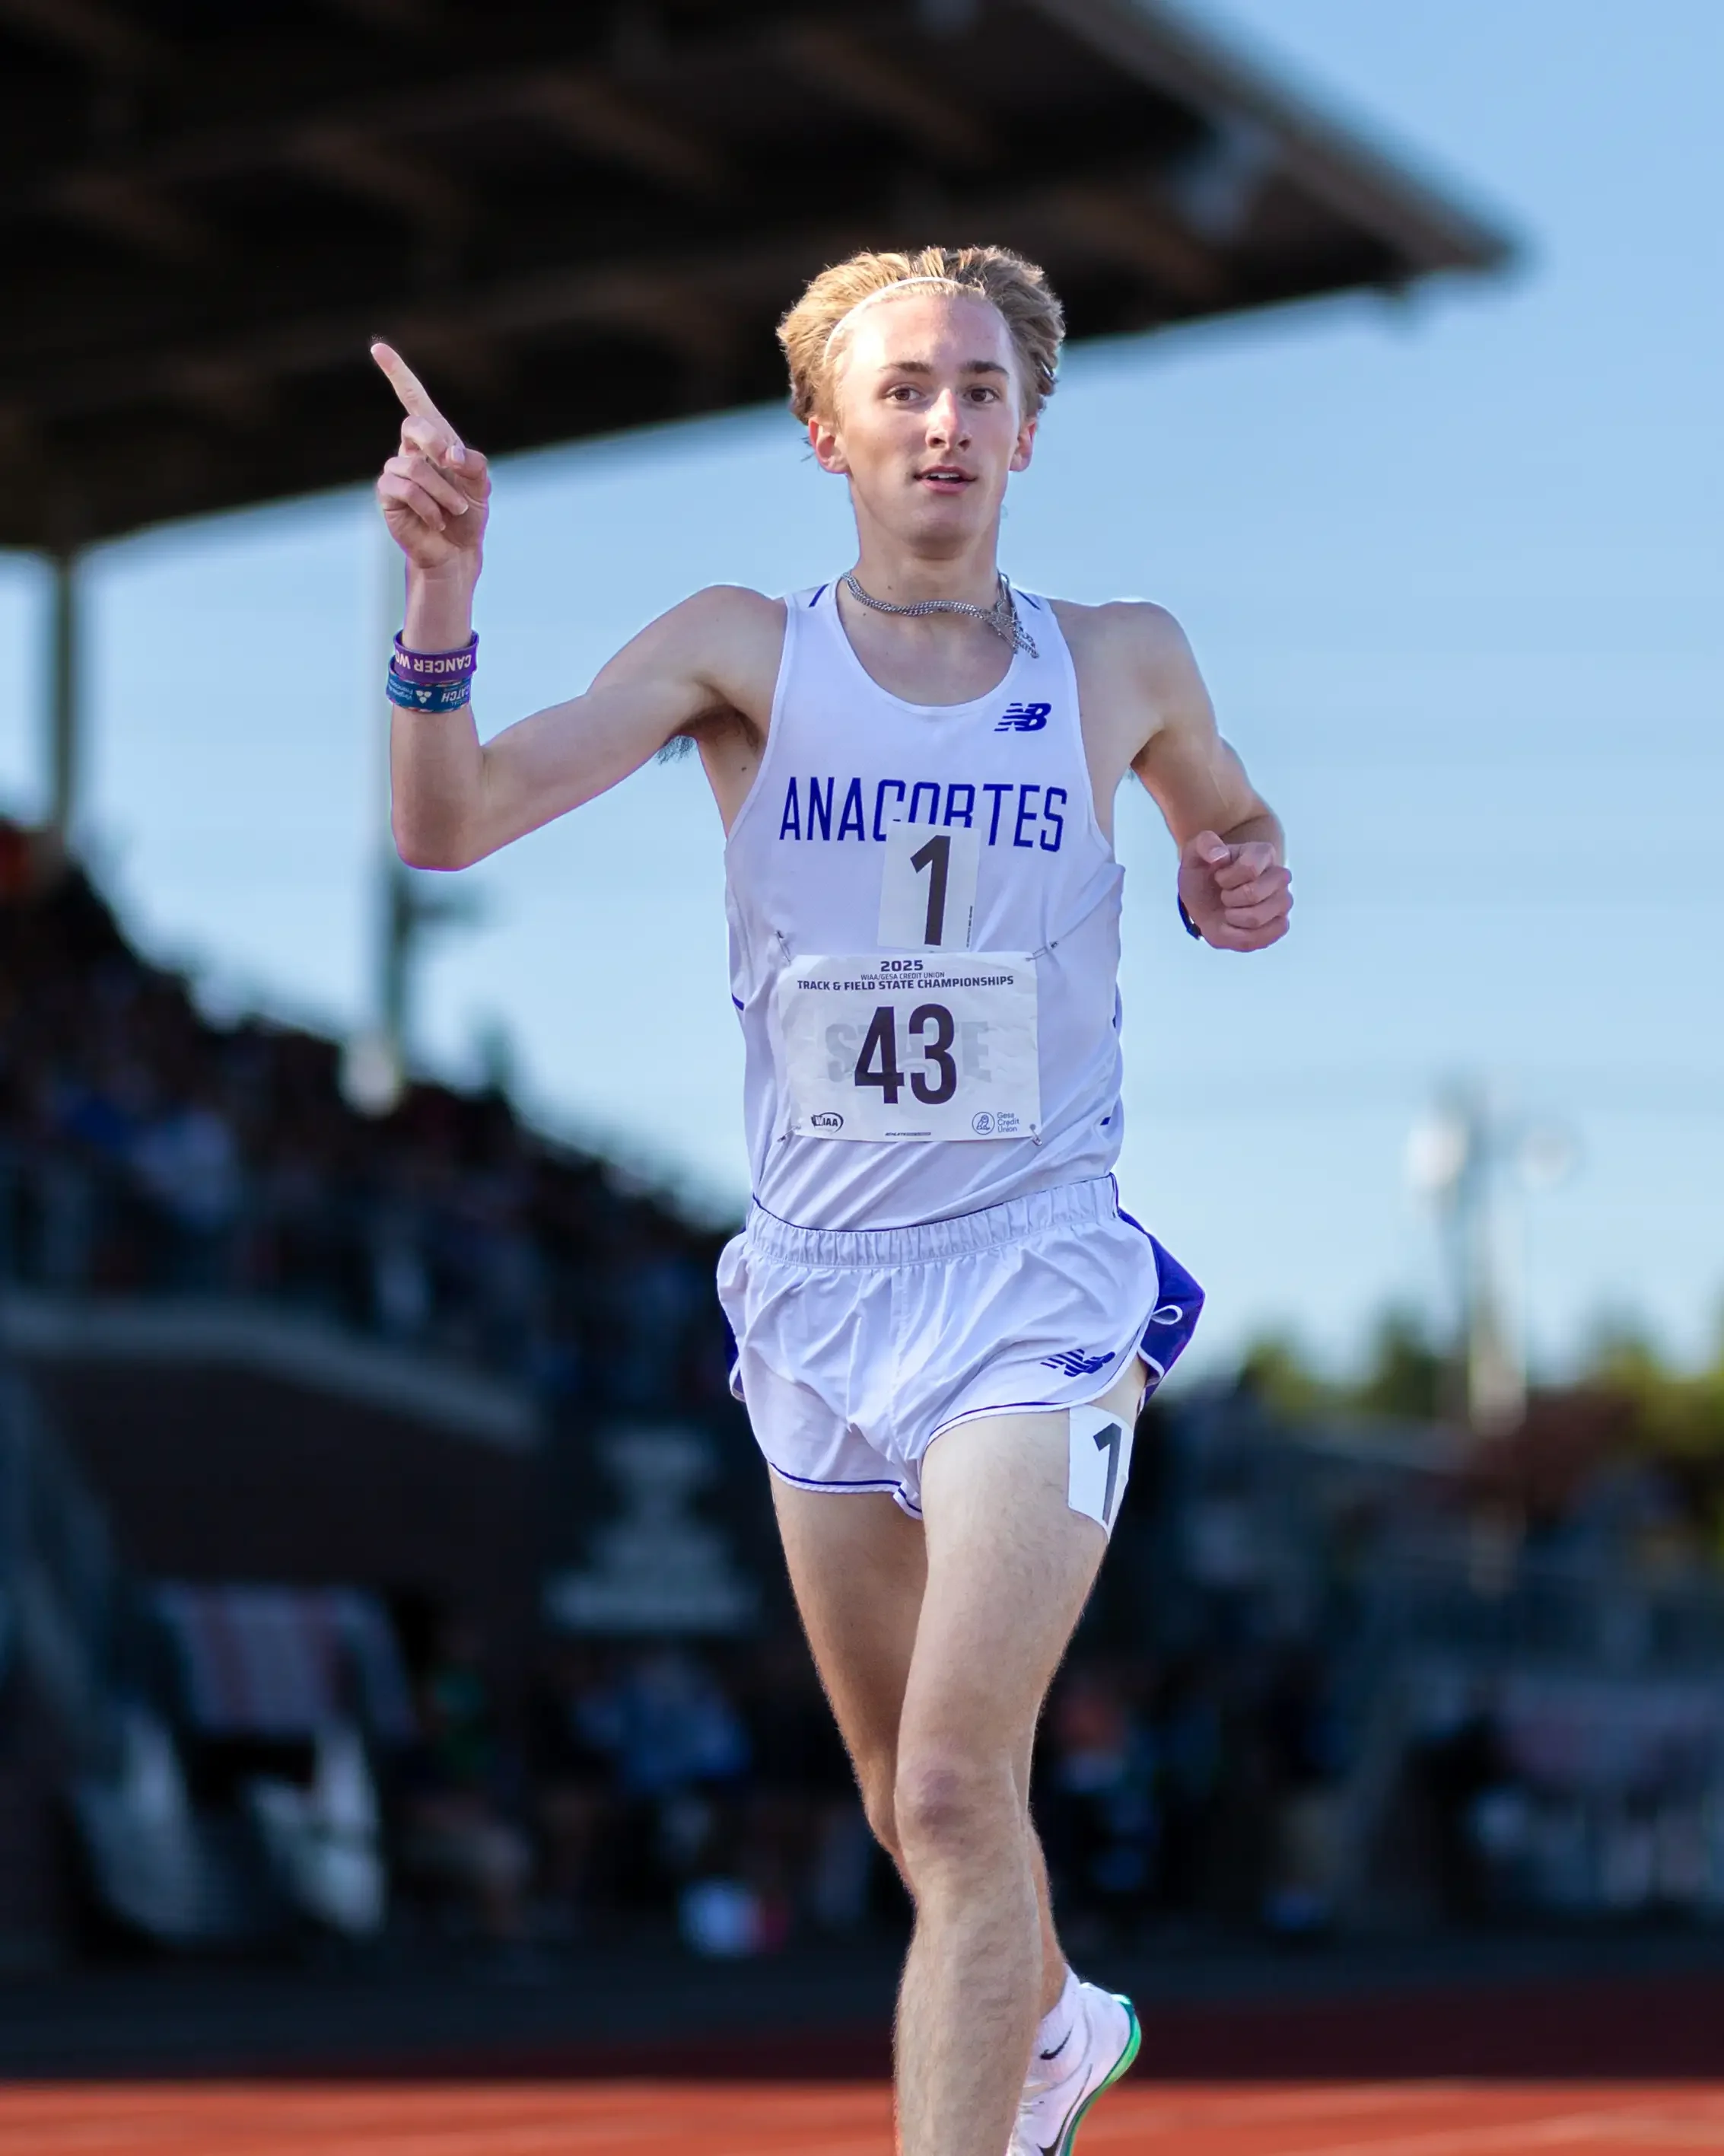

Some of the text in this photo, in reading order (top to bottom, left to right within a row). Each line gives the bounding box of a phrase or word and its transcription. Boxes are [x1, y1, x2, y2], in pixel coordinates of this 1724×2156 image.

[413, 654, 472, 674] CANCER
[778, 776, 1068, 853] ANACORTES
[910, 834, 951, 947] 1
[797, 976, 1014, 991] TRACK & FIELD STATE CHAMPIONSHIPS
[880, 960, 924, 972] 2025
[854, 1003, 957, 1105] 43
[1093, 1422, 1122, 1526] 1
